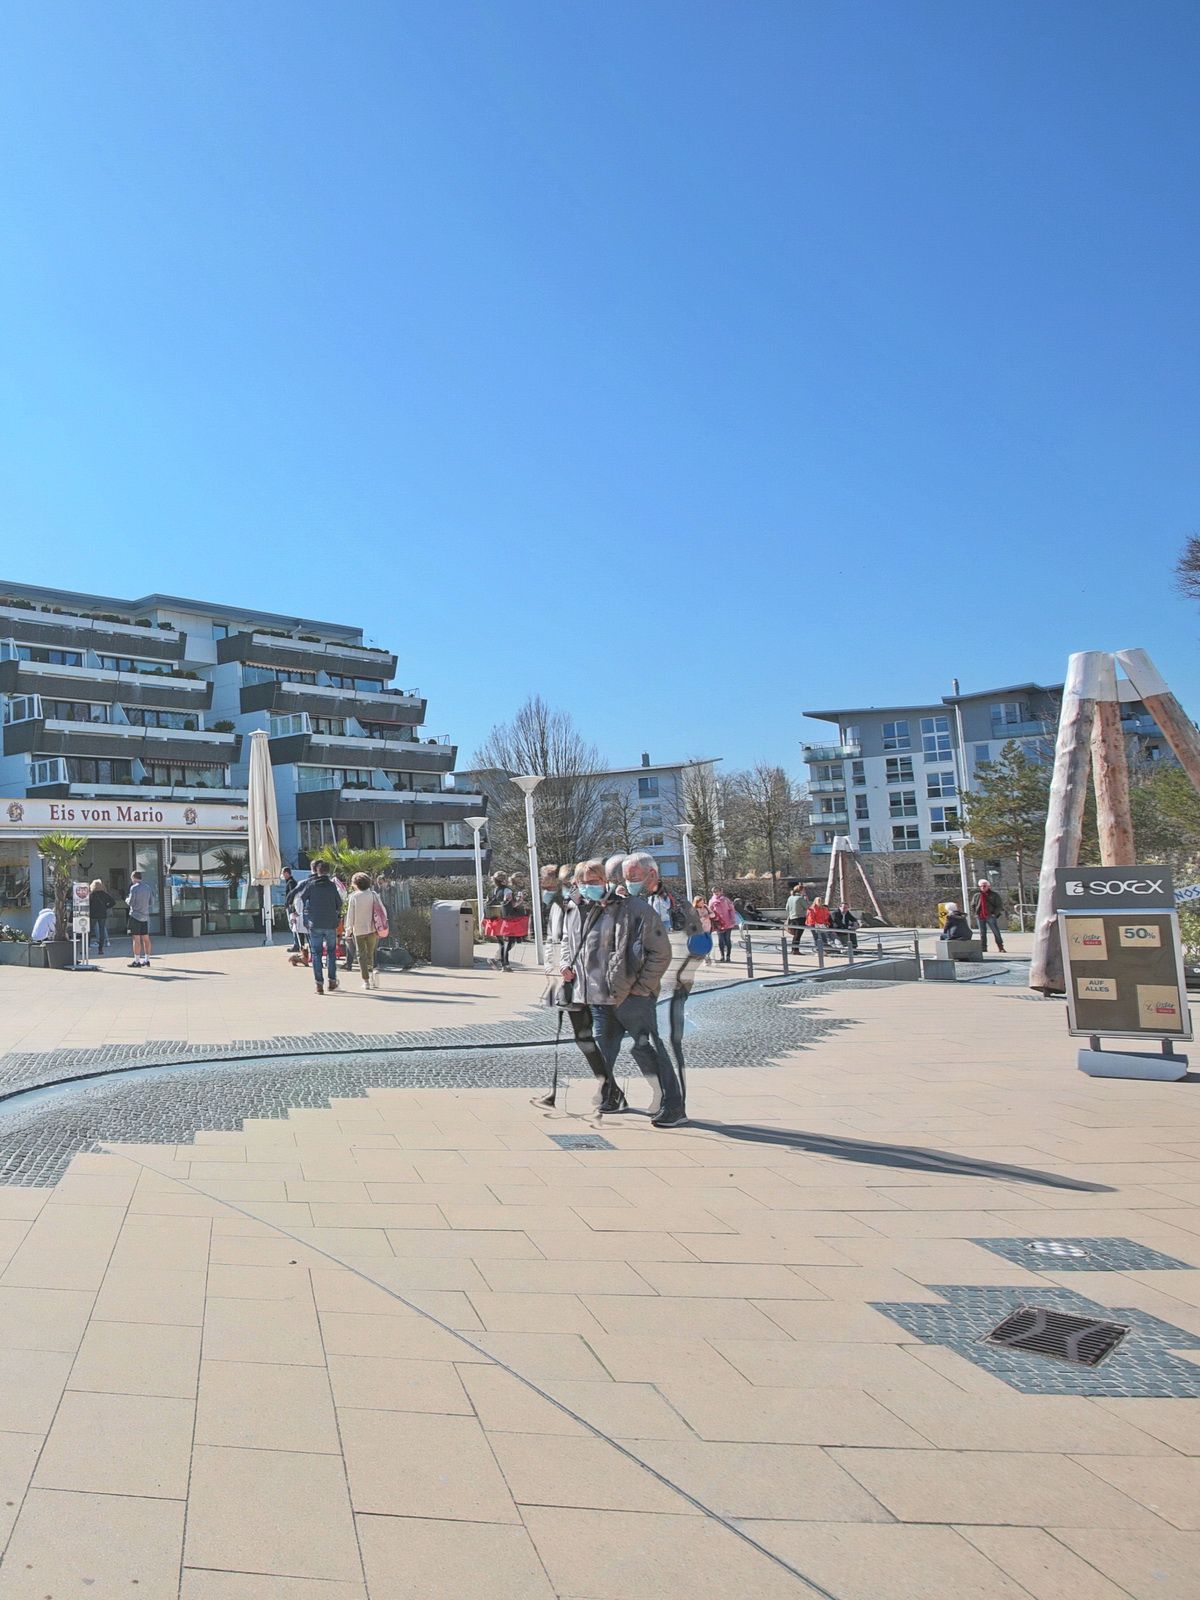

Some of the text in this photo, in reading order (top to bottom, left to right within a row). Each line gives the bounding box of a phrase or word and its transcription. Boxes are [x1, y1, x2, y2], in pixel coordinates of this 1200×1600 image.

[49, 804, 163, 823] Eis von Mario
[1124, 928, 1156, 939] 50%
